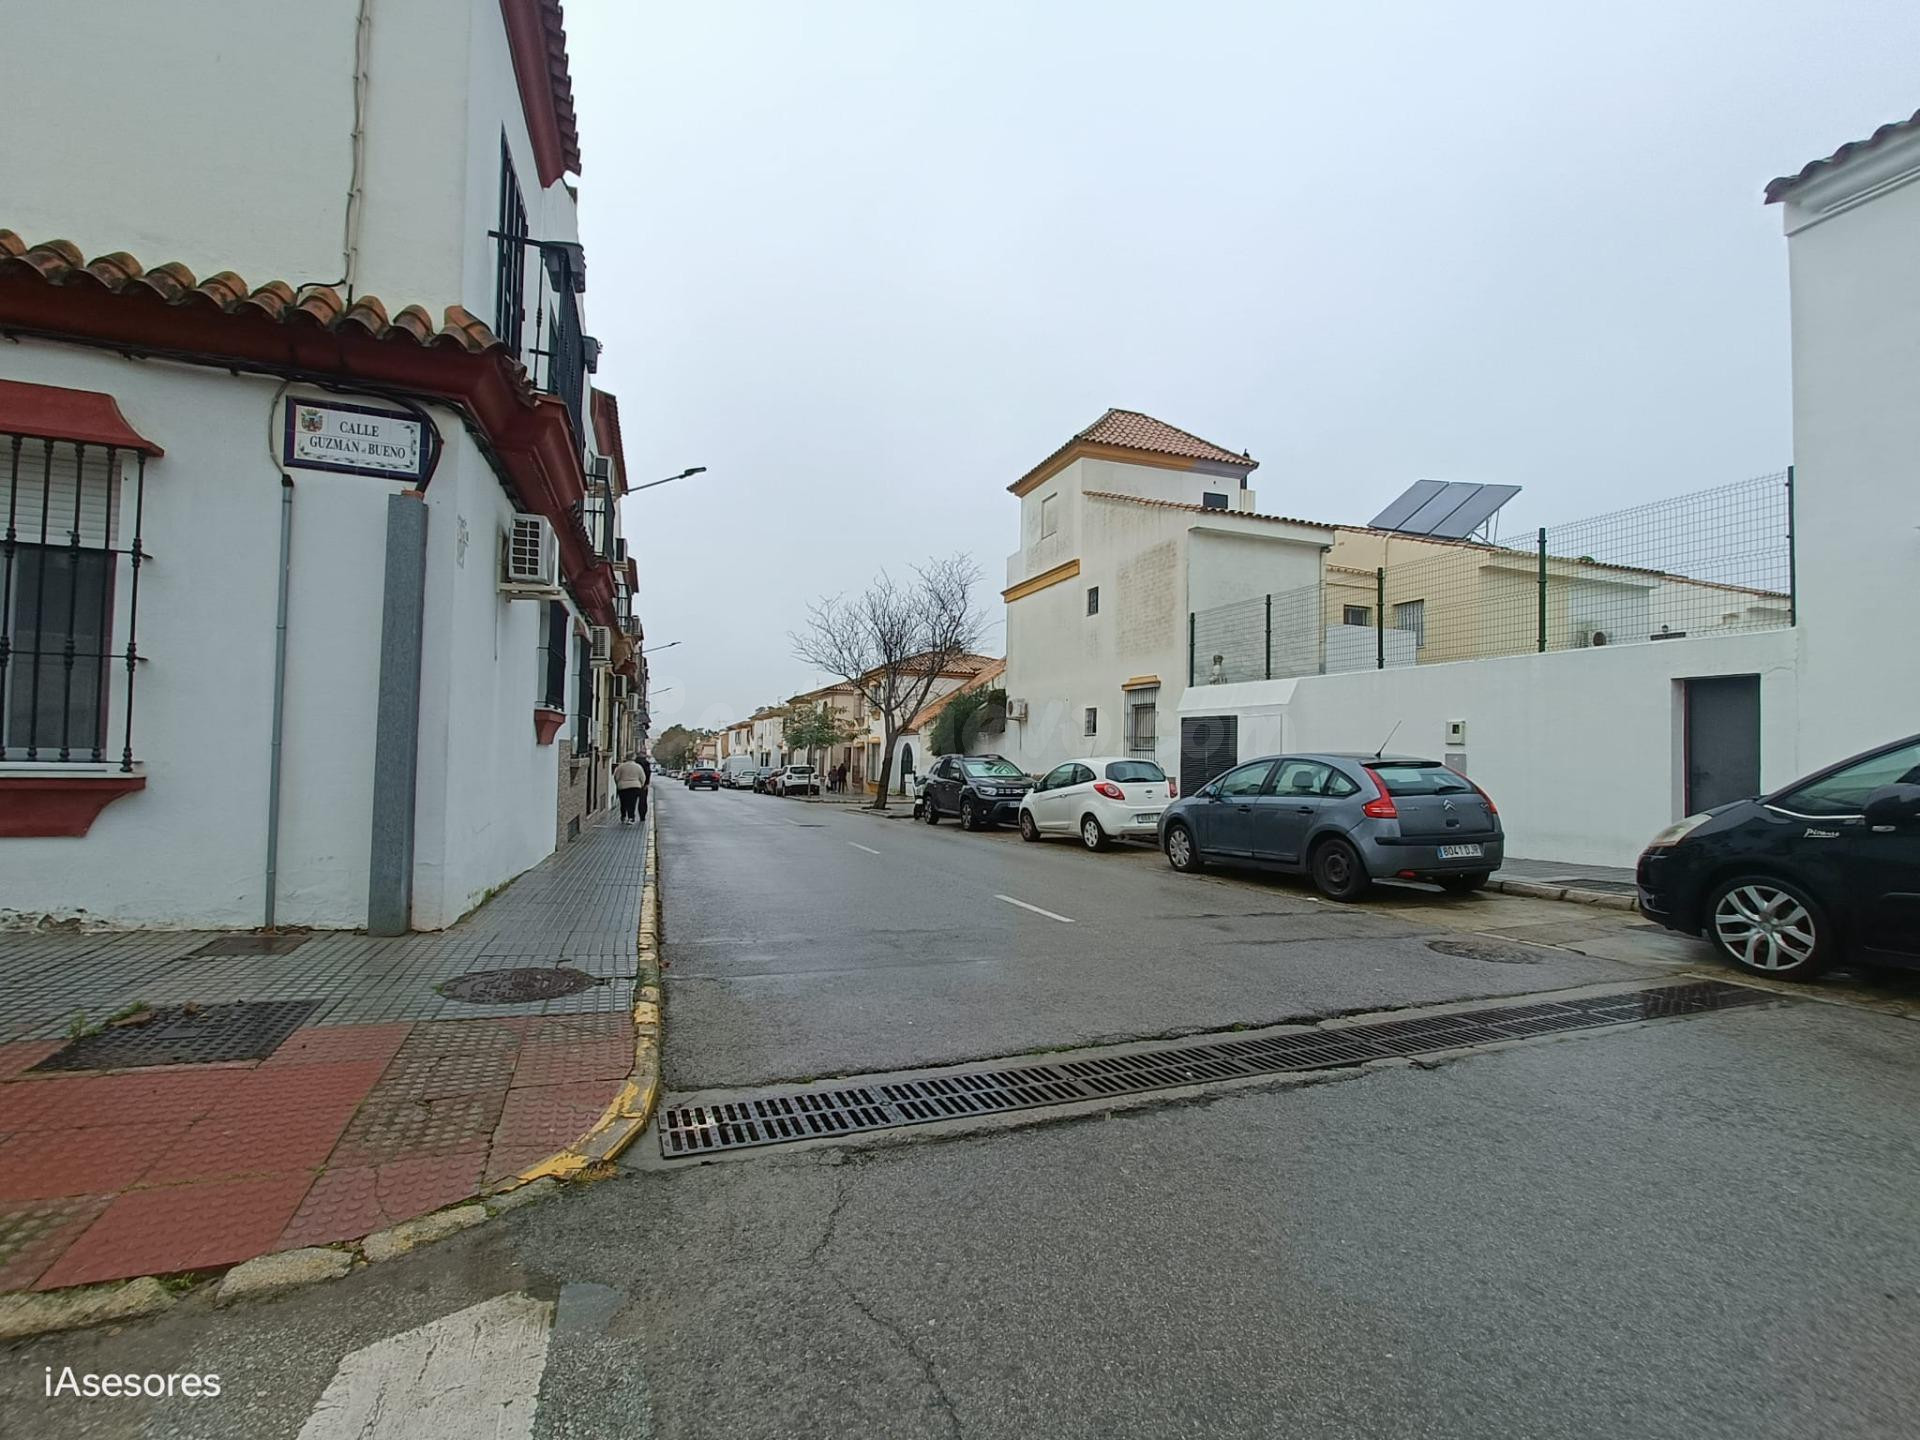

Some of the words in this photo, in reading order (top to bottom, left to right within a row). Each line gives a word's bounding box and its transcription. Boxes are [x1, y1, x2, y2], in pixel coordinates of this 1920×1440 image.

[339, 420, 380, 437] CALLE
[309, 435, 360, 453] GUZMÁN
[368, 443, 406, 459] BUENO
